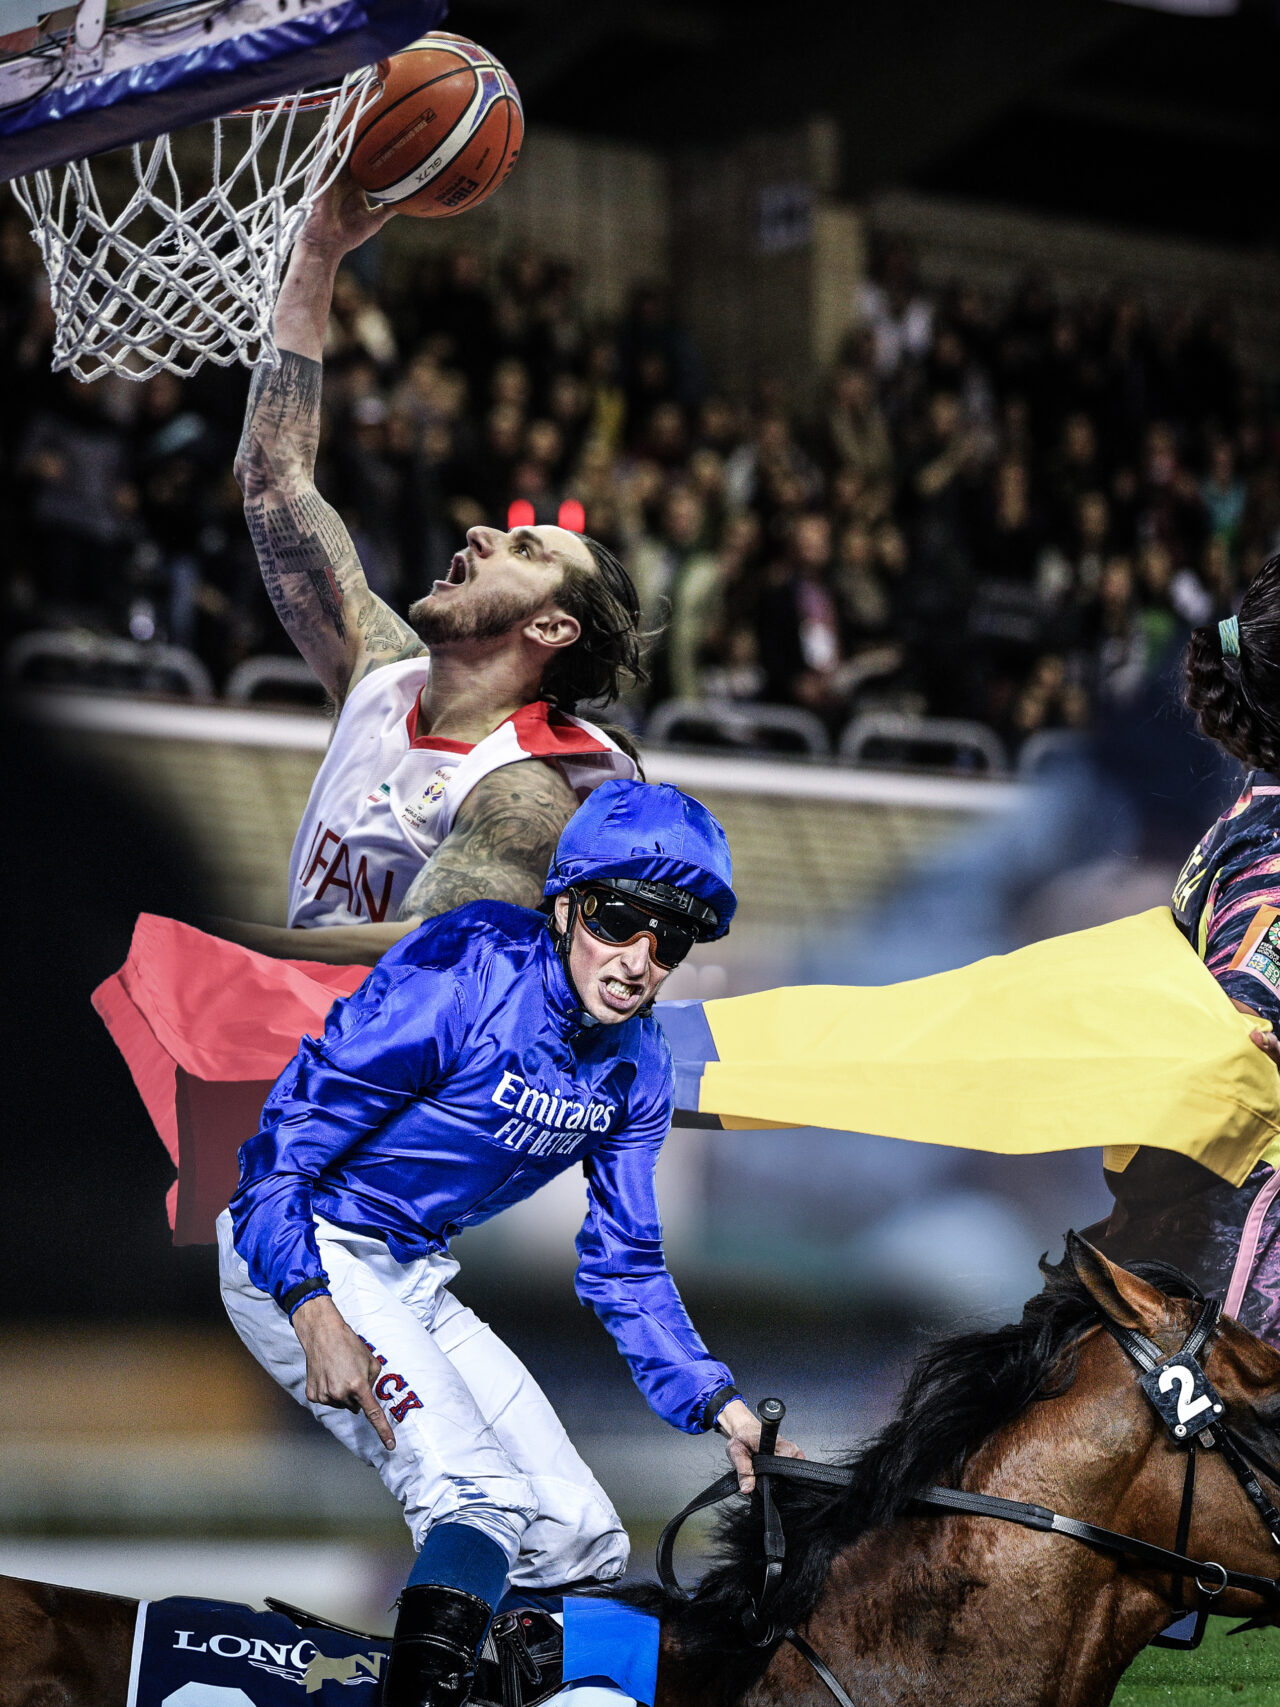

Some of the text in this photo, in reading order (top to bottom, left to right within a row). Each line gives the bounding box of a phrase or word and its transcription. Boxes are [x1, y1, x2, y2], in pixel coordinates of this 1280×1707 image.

[415, 157, 443, 183] GL7X
[442, 174, 480, 208] FIBA
[491, 1070, 616, 1133] Emirates
[493, 1117, 538, 1150] FLY
[1158, 1365, 1213, 1425] 2
